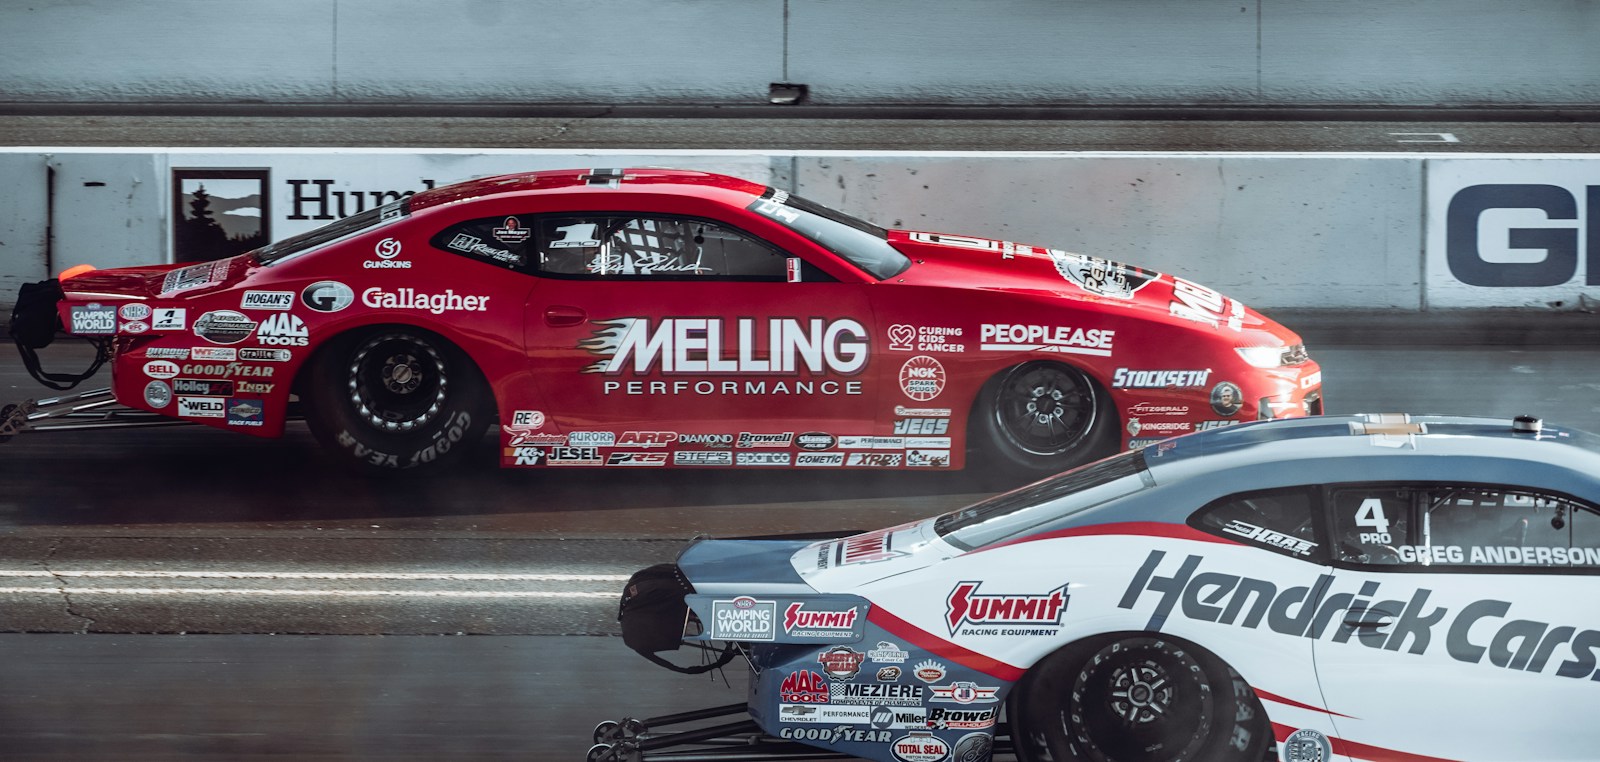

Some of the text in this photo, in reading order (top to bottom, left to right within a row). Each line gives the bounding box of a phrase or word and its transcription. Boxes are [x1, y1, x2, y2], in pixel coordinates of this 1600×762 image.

[554, 223, 598, 242] 1
[245, 293, 292, 304] HOGAN'S
[361, 287, 490, 315] Gallagher
[72, 311, 115, 320] CAMPING
[72, 319, 115, 330] WORLD
[256, 312, 309, 337] MAC
[918, 326, 963, 336] CURING
[257, 336, 309, 346] TOOLS
[918, 335, 945, 344] KIDS
[980, 324, 1115, 348] PEOPLEASE
[603, 317, 869, 375] MELLING
[918, 343, 965, 352] CANCER
[148, 365, 176, 373] BELL
[183, 362, 275, 378] GOODYEAR
[908, 368, 937, 378] NGK
[1112, 368, 1211, 388] STOCKSETH
[174, 381, 210, 395] Holley
[603, 381, 863, 395] PERFORMANCE
[188, 401, 224, 411] WELD
[893, 418, 950, 435] JEGS
[568, 432, 615, 441] AURORA
[617, 432, 677, 445] ARP
[679, 434, 734, 443] DIAMOND
[740, 433, 793, 442] Browell
[548, 447, 601, 460] JESEL
[736, 452, 791, 466] sparco
[797, 455, 842, 464] COMETIC
[1354, 498, 1390, 533] 4
[1360, 533, 1392, 544] PRO
[1398, 545, 1600, 565] GREG ANDERSON
[947, 582, 1066, 633] SUMMIT
[717, 609, 770, 620] CAMPING
[784, 602, 858, 633] SUMMIT
[717, 620, 770, 633] WORLD
[780, 669, 829, 694] MAC
[844, 684, 923, 697] MEZIERE
[780, 694, 829, 703] TOOLS
[895, 713, 927, 724] Miller
[780, 725, 892, 744] GOODYEAR
[897, 744, 944, 755] TOTAL SEAL
